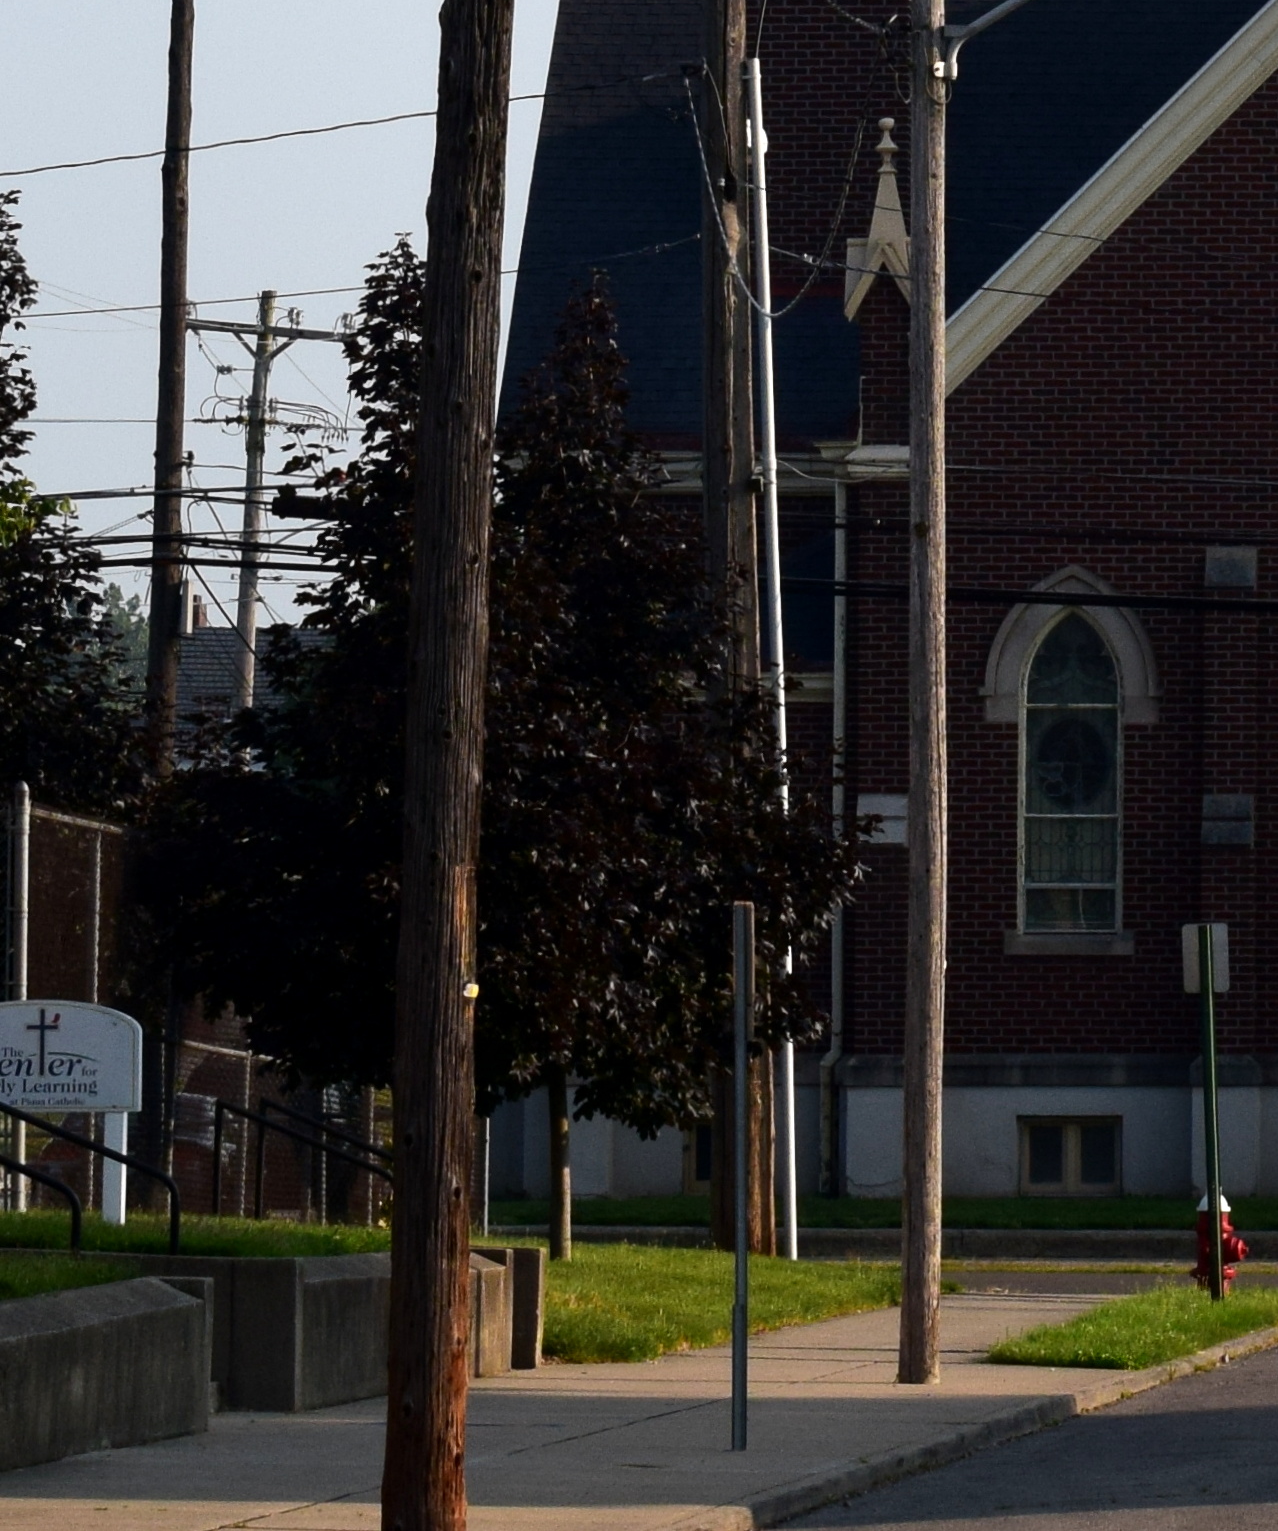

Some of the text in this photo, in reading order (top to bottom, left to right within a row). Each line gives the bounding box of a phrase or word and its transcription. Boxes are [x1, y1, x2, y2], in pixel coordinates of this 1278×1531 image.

[1, 1046, 24, 1058] The
[81, 1067, 98, 1077] for
[22, 1079, 98, 1096] Learning
[9, 1098, 19, 1106] at
[48, 1097, 86, 1106] Catholic
